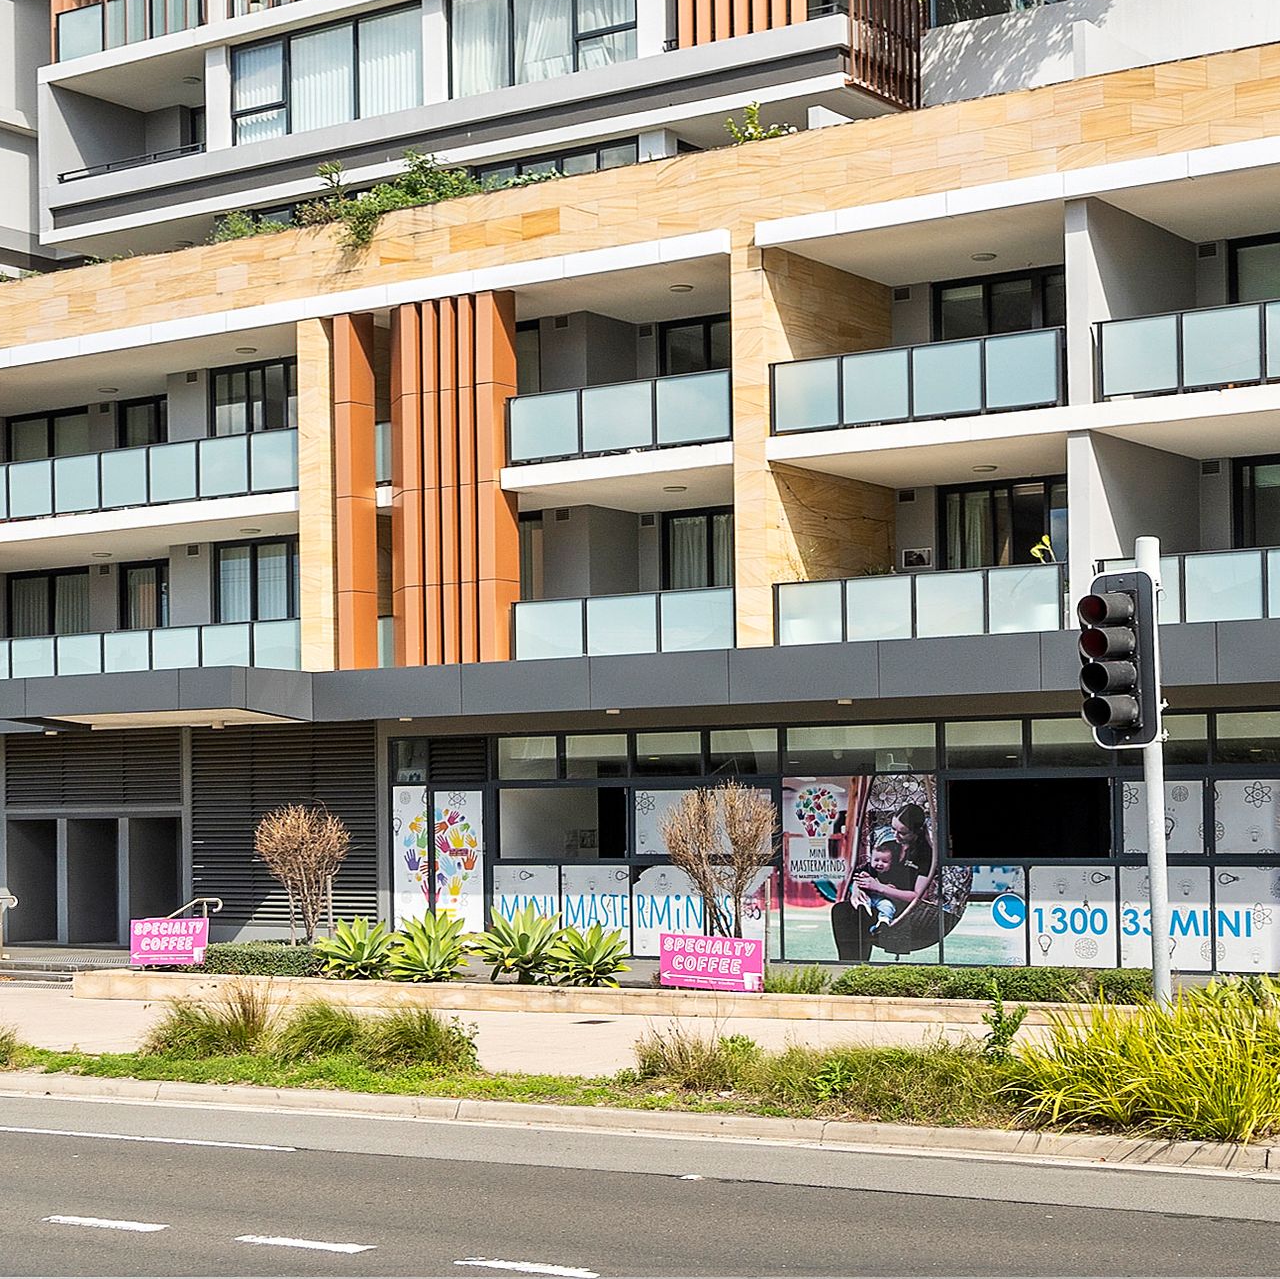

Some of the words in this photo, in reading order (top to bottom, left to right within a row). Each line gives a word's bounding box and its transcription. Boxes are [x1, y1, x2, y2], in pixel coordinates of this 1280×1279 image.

[809, 849, 826, 858] MINI
[133, 921, 204, 936] SPECIALTY
[1032, 907, 1109, 936] 1300
[1169, 909, 1252, 938] MINI
[140, 936, 194, 951] COFFEE
[663, 937, 756, 957] SPECIALTY
[672, 954, 743, 975] COFFEE
